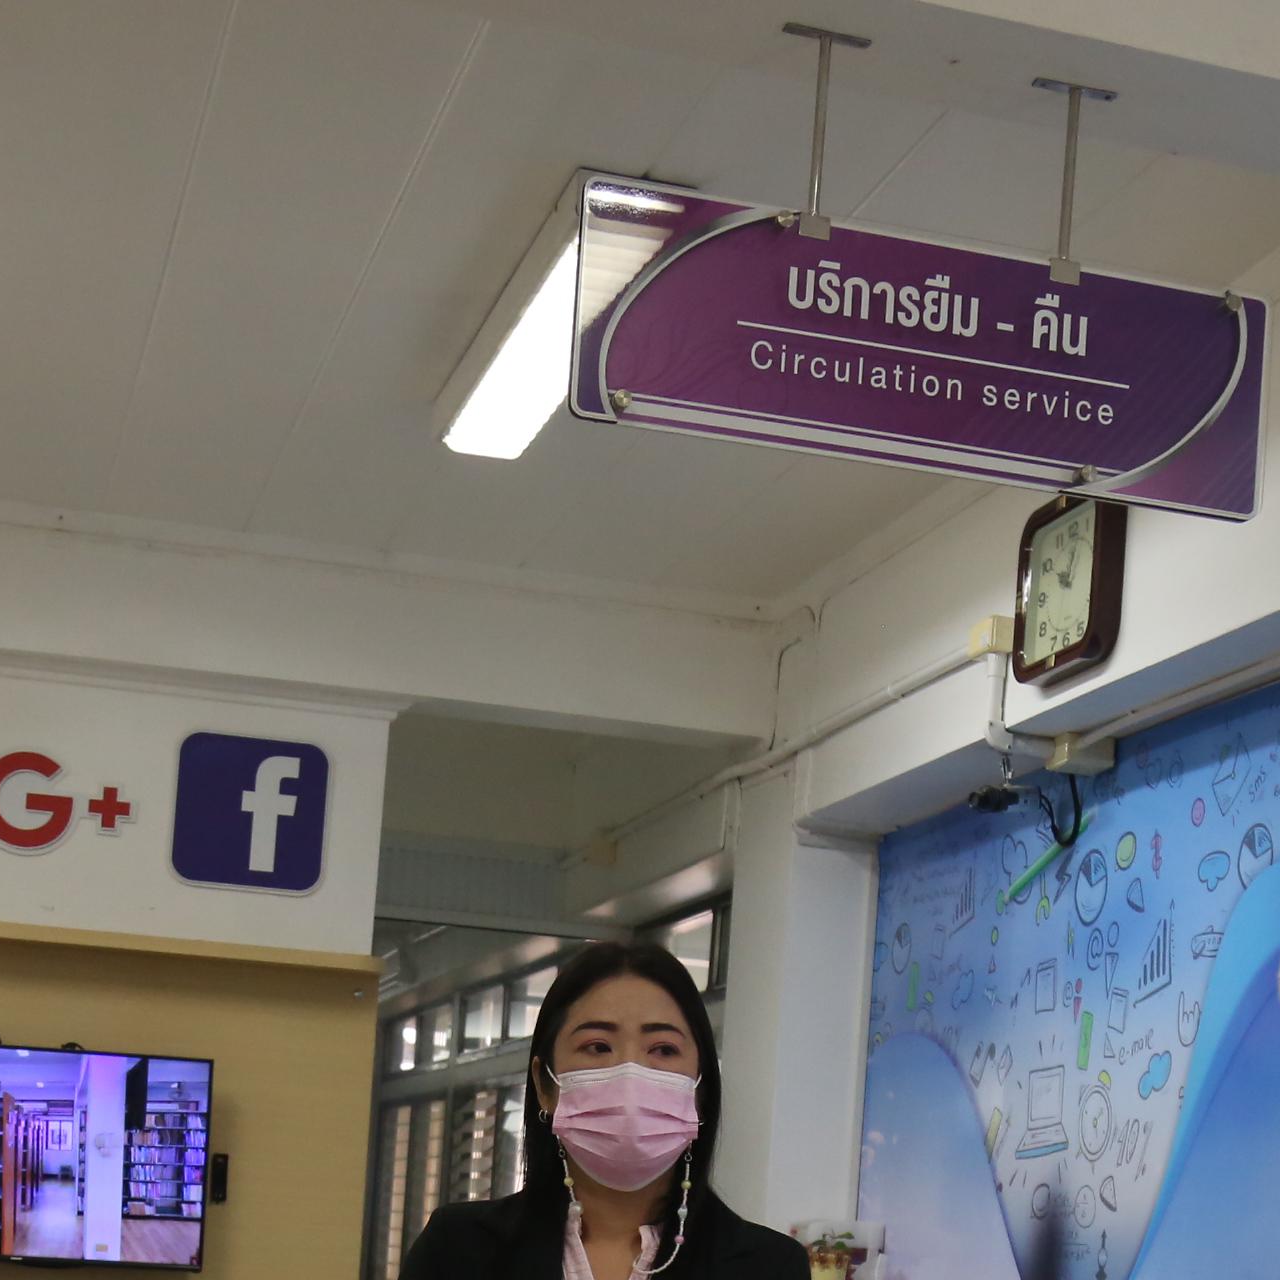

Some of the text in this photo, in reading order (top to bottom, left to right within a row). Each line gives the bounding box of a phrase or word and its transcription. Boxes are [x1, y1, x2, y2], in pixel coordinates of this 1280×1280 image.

[786, 259, 981, 339] บริการยืม
[1030, 291, 1089, 358] คืน
[750, 339, 1116, 426] Circulation service
[1038, 592, 1047, 608] 9
[1038, 621, 1047, 638] 8
[1076, 620, 1086, 638] 5
[1050, 635, 1058, 652] 7
[1061, 631, 1071, 648] 6
[240, 756, 302, 874] f
